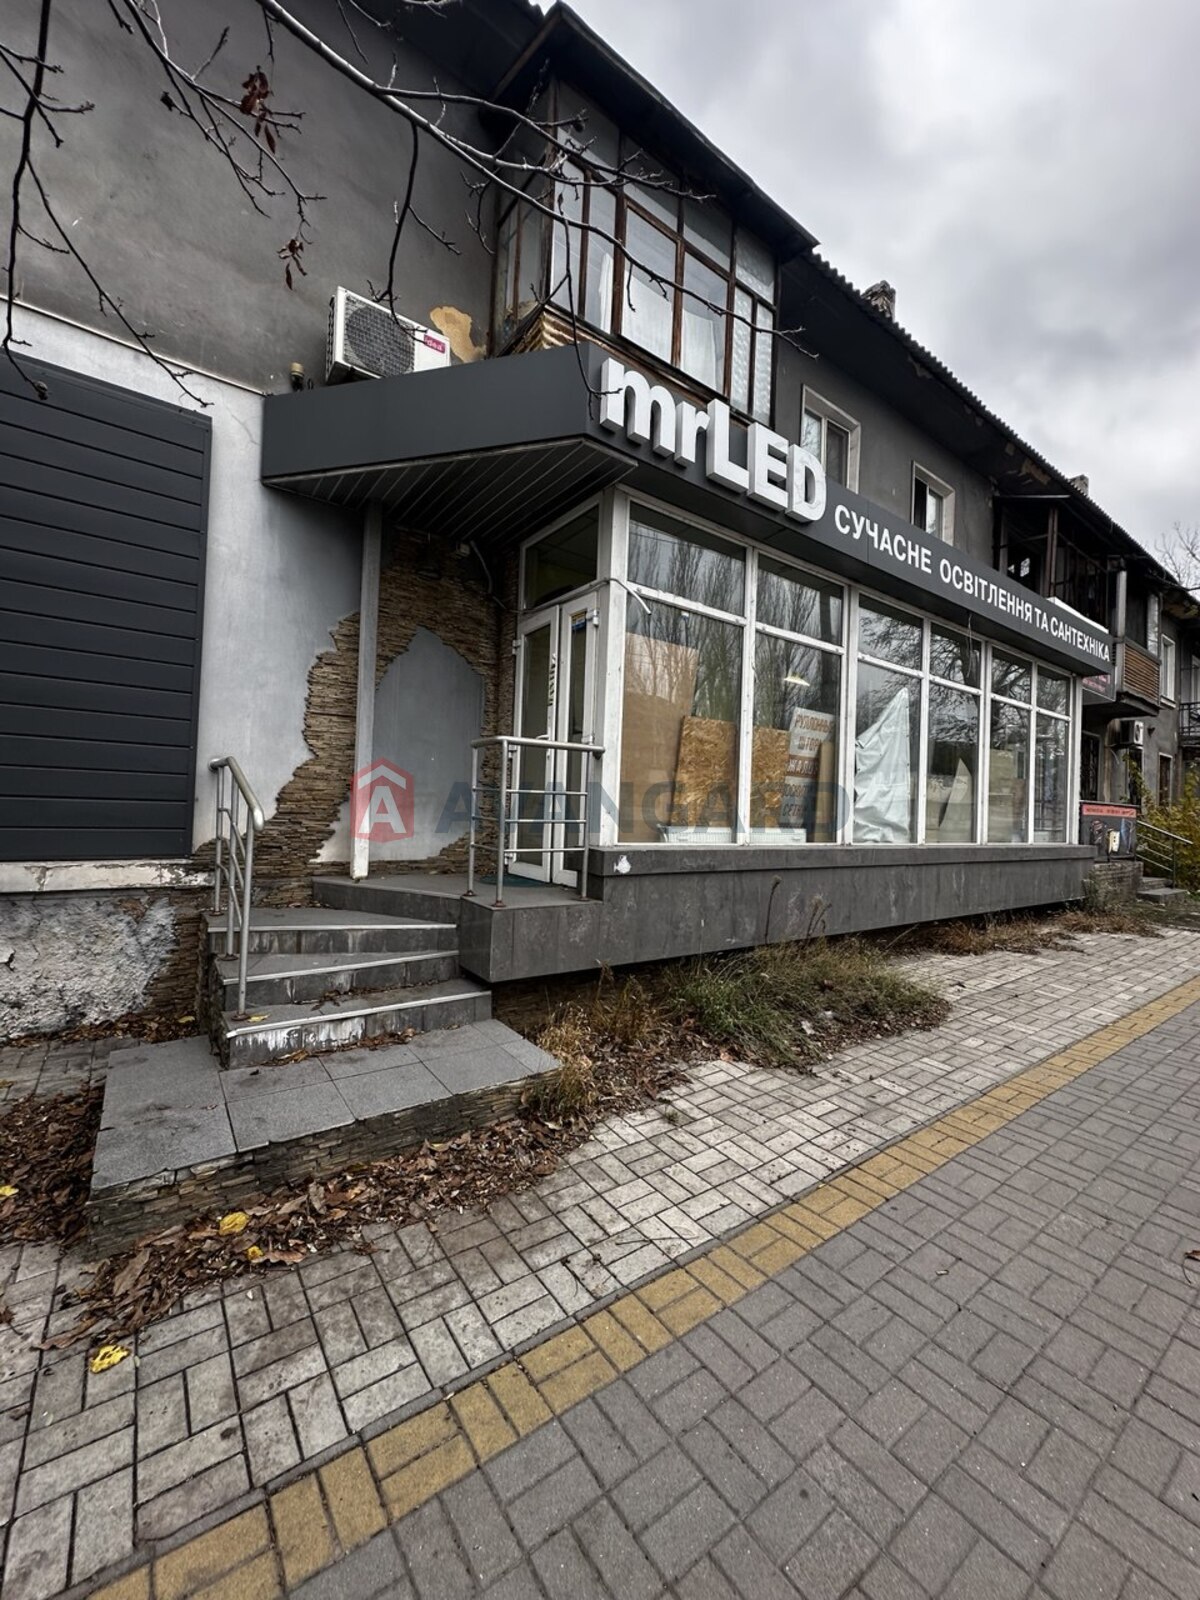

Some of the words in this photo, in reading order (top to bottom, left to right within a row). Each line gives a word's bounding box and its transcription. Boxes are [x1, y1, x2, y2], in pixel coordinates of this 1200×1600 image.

[600, 357, 827, 523] mrLED
[834, 504, 932, 574] СУЧАСНЕ
[939, 558, 1033, 624] ОСВІТЛЕННЯ
[1034, 607, 1049, 632] ТА
[1050, 616, 1110, 662] САНТЕХНІКА
